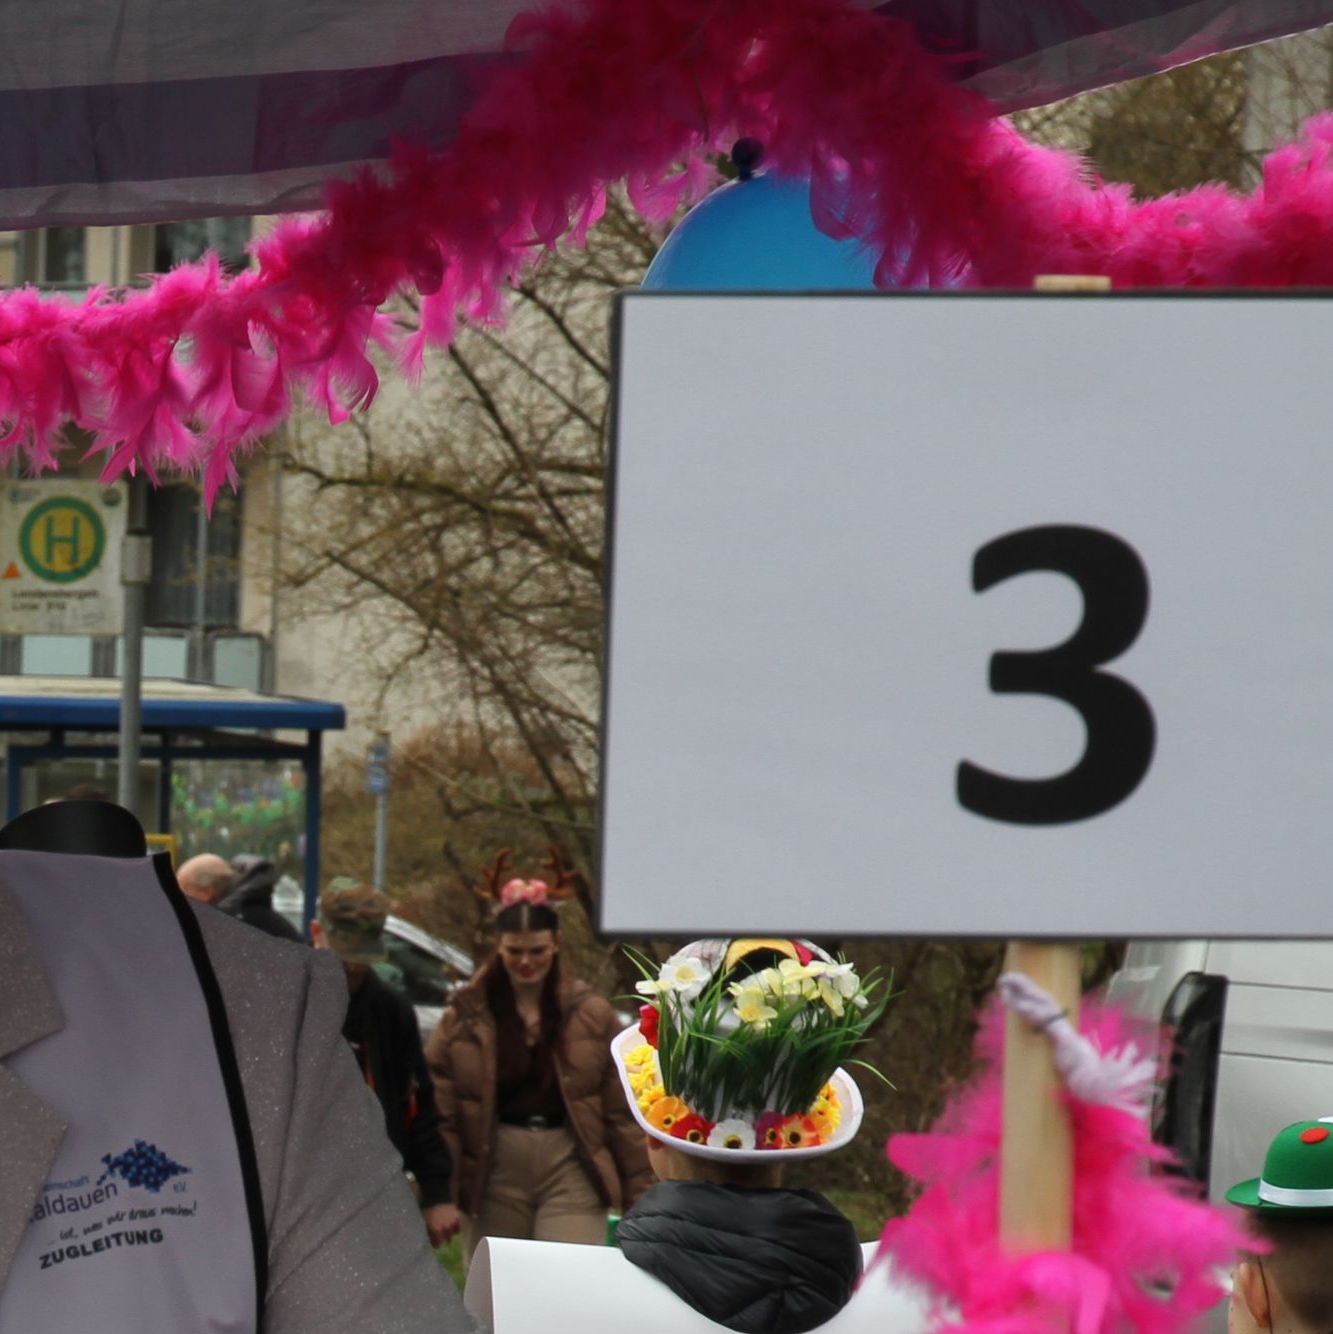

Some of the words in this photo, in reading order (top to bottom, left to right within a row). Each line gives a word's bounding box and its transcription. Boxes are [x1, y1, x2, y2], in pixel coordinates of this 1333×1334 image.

[44, 516, 80, 563] H
[955, 522, 1158, 828] 3
[30, 1182, 118, 1223] aldauen
[39, 1228, 164, 1270] ZUGLEITUNG
